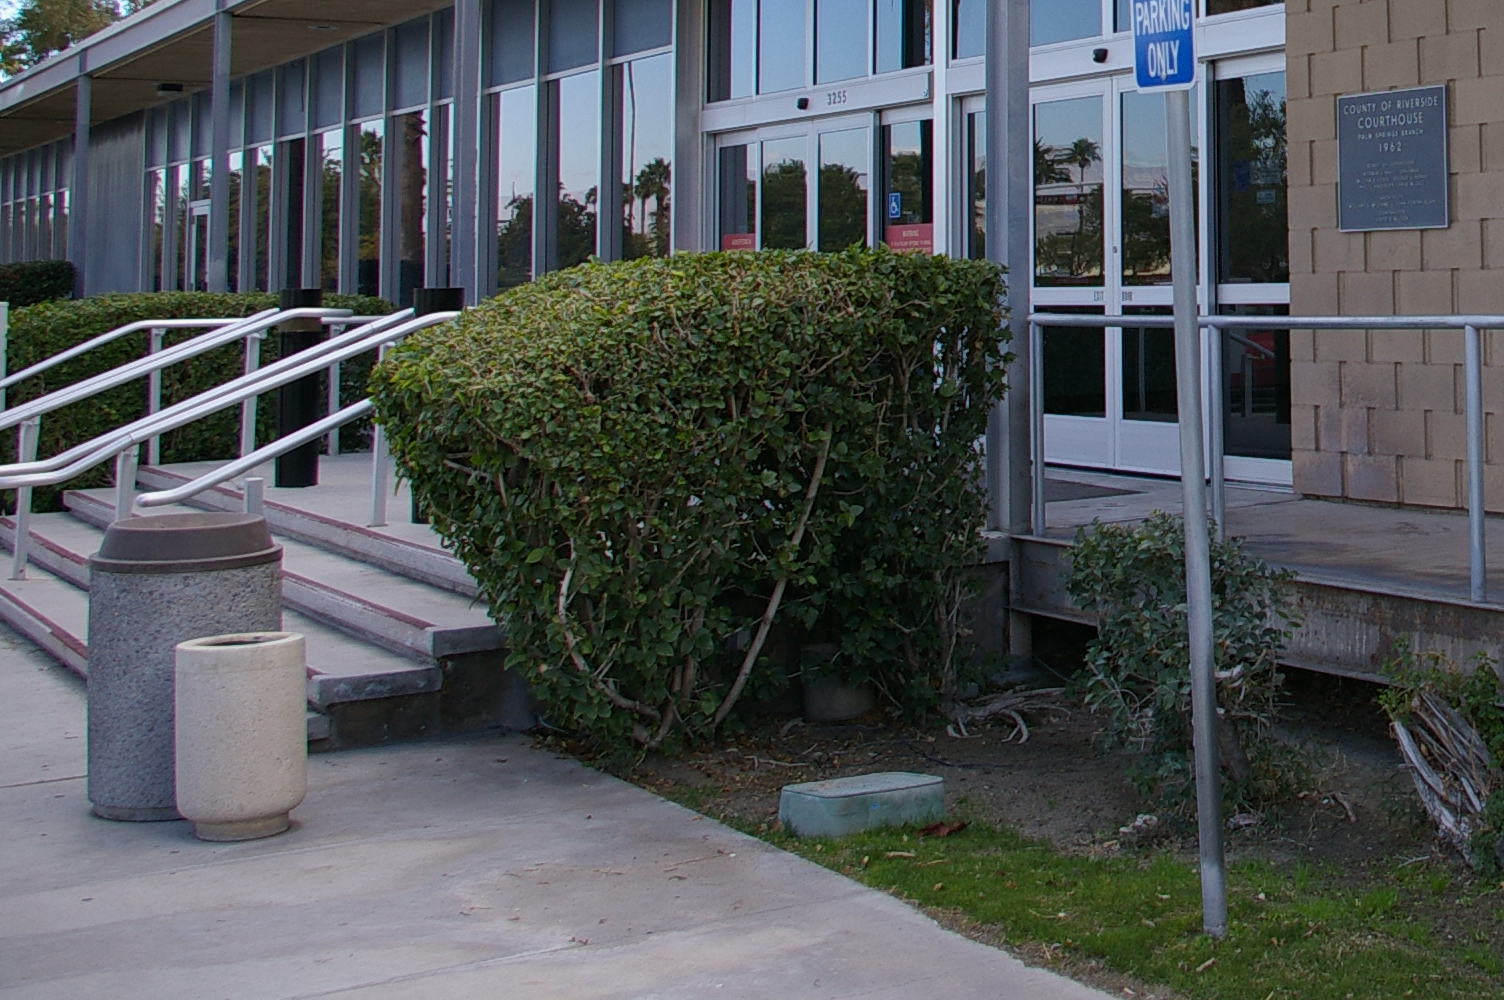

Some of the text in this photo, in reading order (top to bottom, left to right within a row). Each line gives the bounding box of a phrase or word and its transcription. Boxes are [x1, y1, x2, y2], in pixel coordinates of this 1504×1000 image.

[1147, 40, 1180, 79] ONLY
[826, 90, 848, 106] 3255
[1344, 96, 1439, 115] COUNTY OF RIVERSIDE
[1357, 111, 1424, 129] COURTHOUSE
[1379, 141, 1402, 153] 1962
